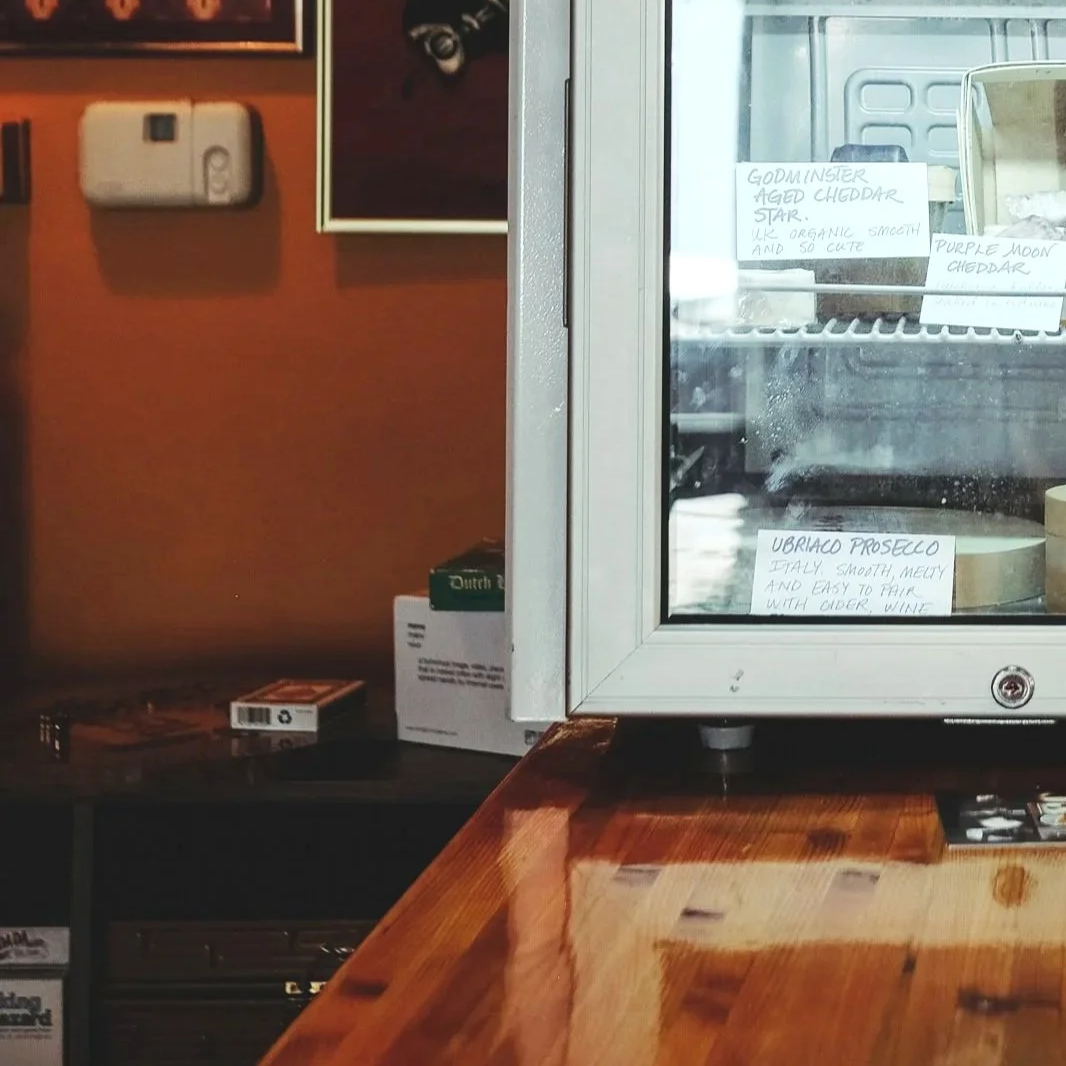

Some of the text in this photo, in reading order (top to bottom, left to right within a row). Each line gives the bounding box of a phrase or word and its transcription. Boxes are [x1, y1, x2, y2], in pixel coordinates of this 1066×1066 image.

[747, 165, 869, 185] GODMINSTER
[753, 186, 904, 206] AGED CHEDDAR
[789, 226, 854, 242] ORGANIC
[868, 223, 922, 238] SMOOTH
[752, 243, 784, 256] AND
[799, 241, 815, 254] SO
[935, 239, 1055, 258] PURPLE MOON
[947, 260, 1031, 276] CHEDDAR
[771, 536, 940, 556] UBRIACO PROSECCO
[900, 565, 948, 580] MELTY
[449, 575, 492, 591] Dutch
[765, 580, 921, 598] AND EASY TO PAIR
[766, 598, 808, 611] WITH
[884, 602, 933, 615] WINE
